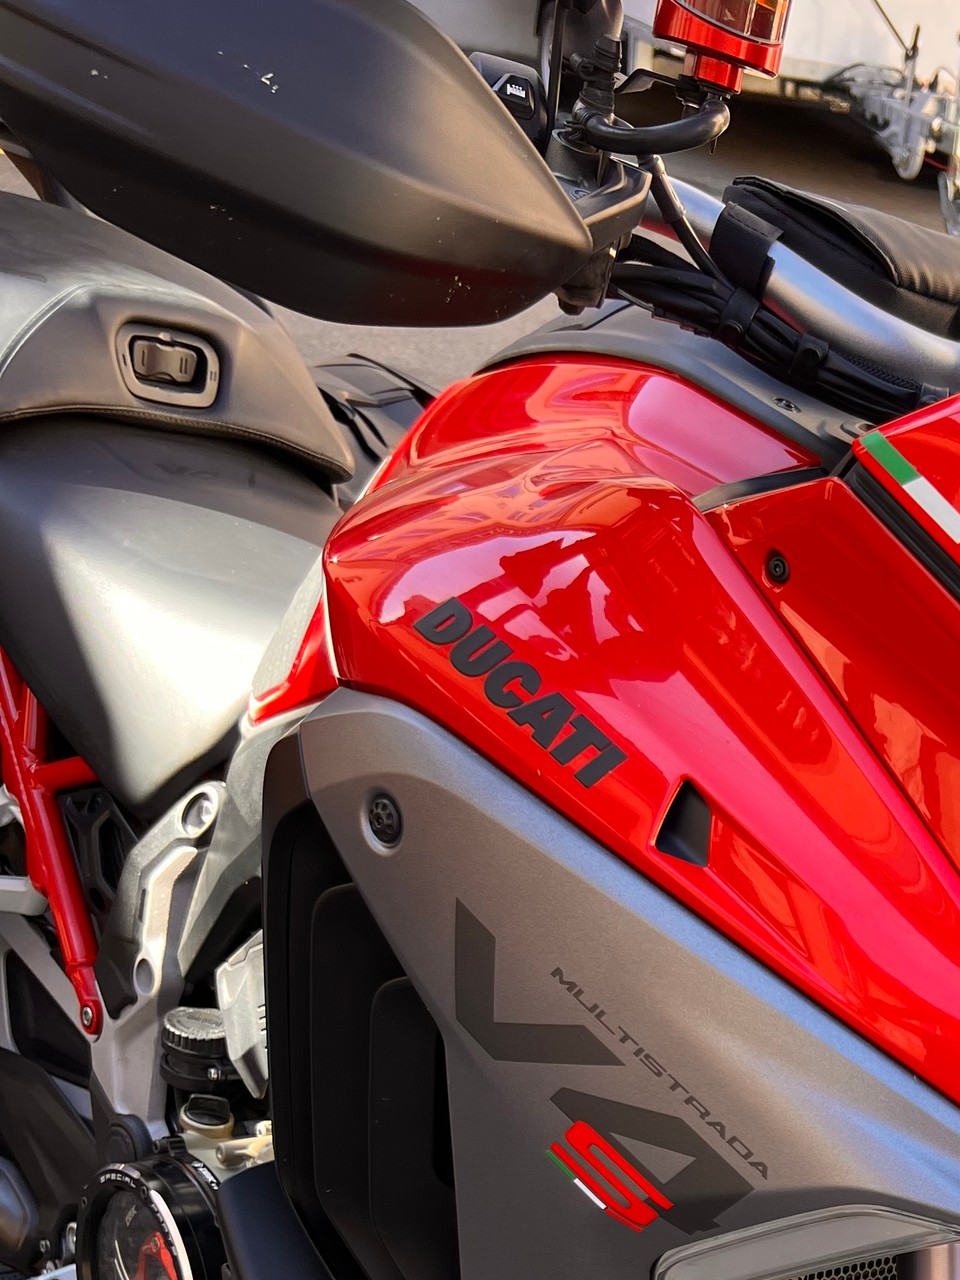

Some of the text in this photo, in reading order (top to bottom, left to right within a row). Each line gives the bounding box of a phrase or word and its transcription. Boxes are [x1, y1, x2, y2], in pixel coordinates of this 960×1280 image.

[412, 596, 629, 789] DUCATI
[550, 966, 768, 1181] MULTISTRADA
[100, 1172, 137, 1188] SPECIAL
